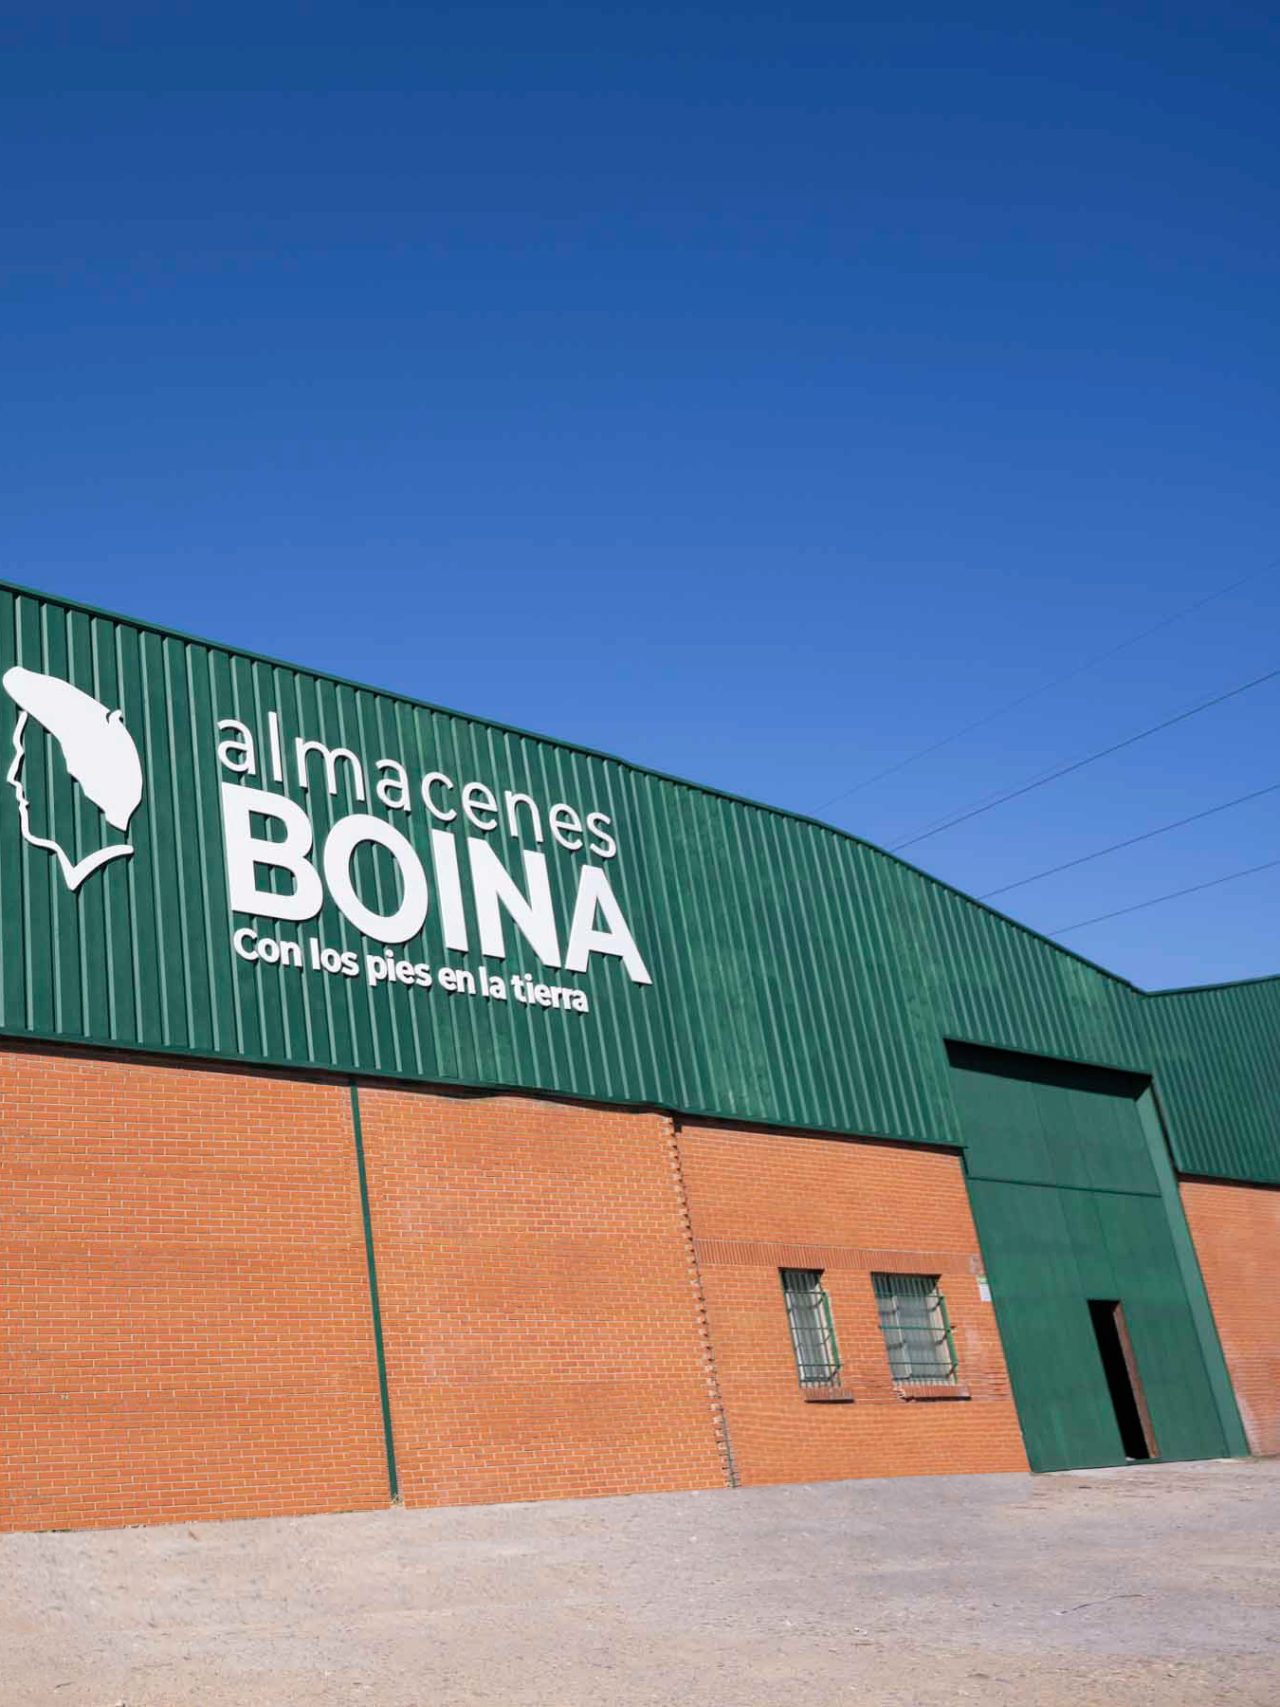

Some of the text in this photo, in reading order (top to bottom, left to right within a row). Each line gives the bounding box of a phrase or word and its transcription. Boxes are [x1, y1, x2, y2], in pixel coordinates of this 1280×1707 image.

[216, 711, 618, 859] almacenes
[221, 781, 653, 985] BOINA
[232, 927, 590, 1013] Con los pies en la tierra
